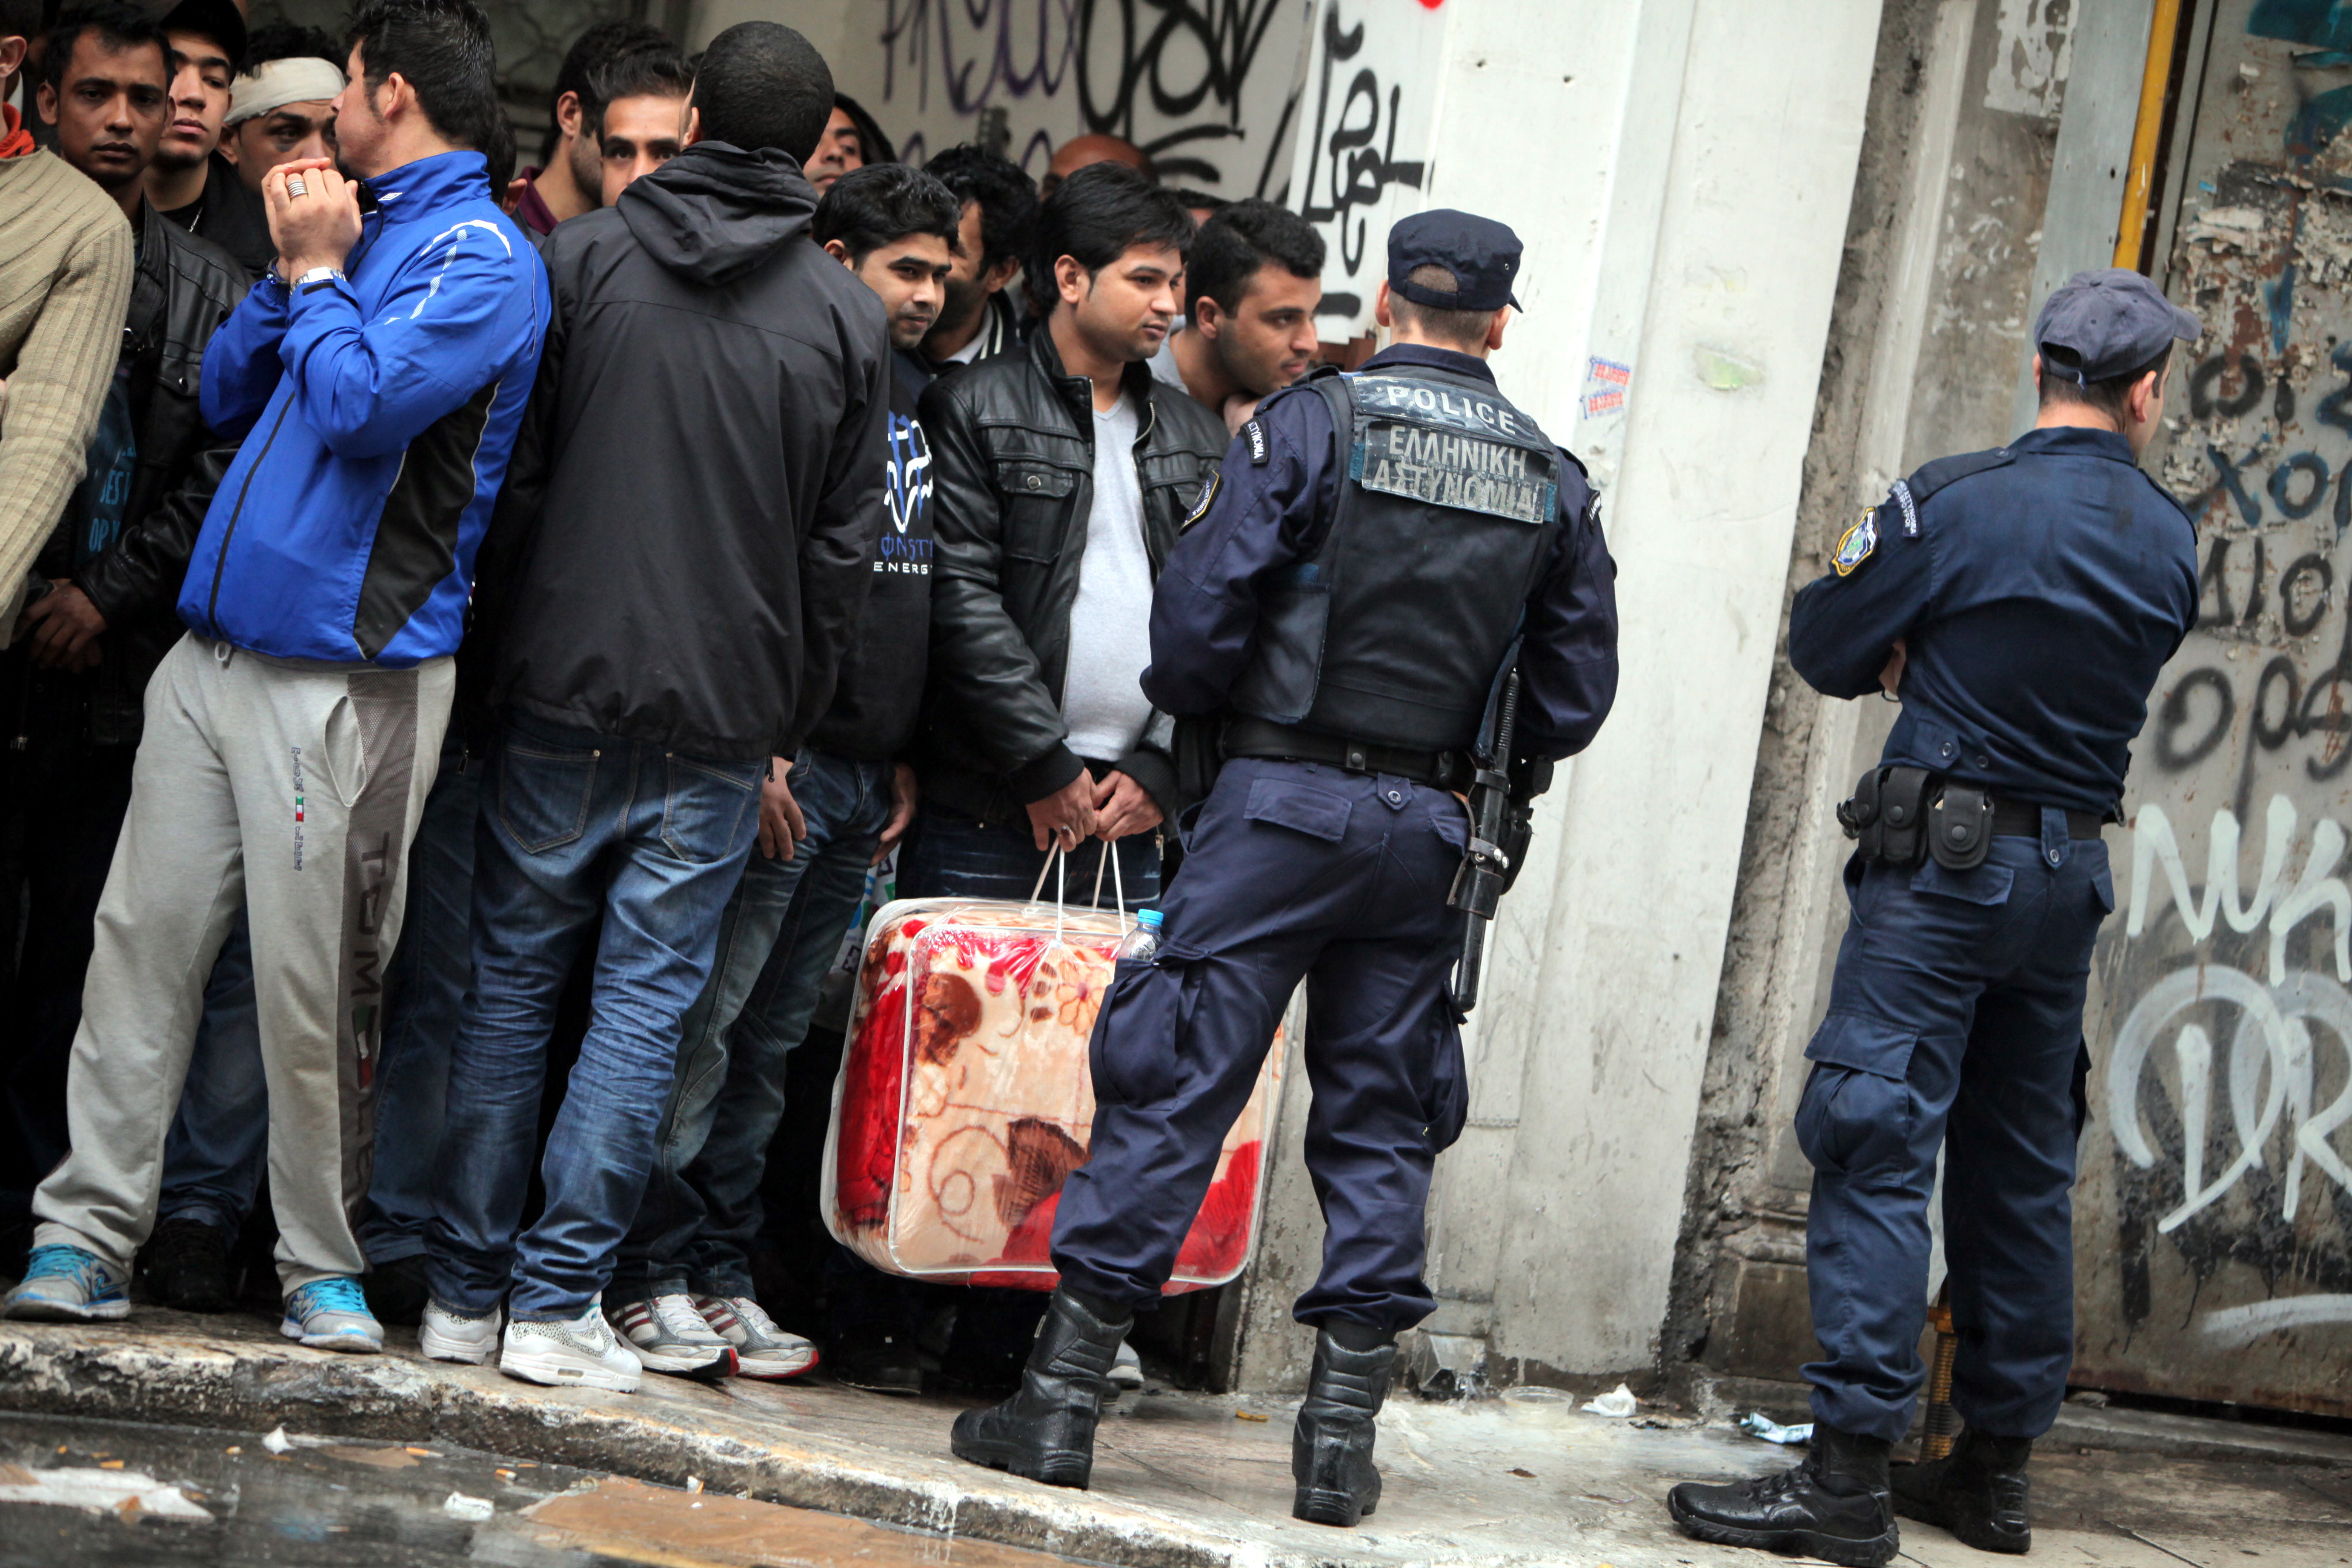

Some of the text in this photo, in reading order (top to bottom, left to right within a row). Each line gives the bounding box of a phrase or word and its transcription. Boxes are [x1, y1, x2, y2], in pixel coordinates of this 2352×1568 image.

[1386, 385, 1516, 435] POLICE
[1389, 425, 1527, 480] ΕΛΛΗΝΙΚΗ
[1371, 459, 1535, 517] ΑΣΤΥΝΟΜΙΑ
[873, 561, 933, 575] ENERG
